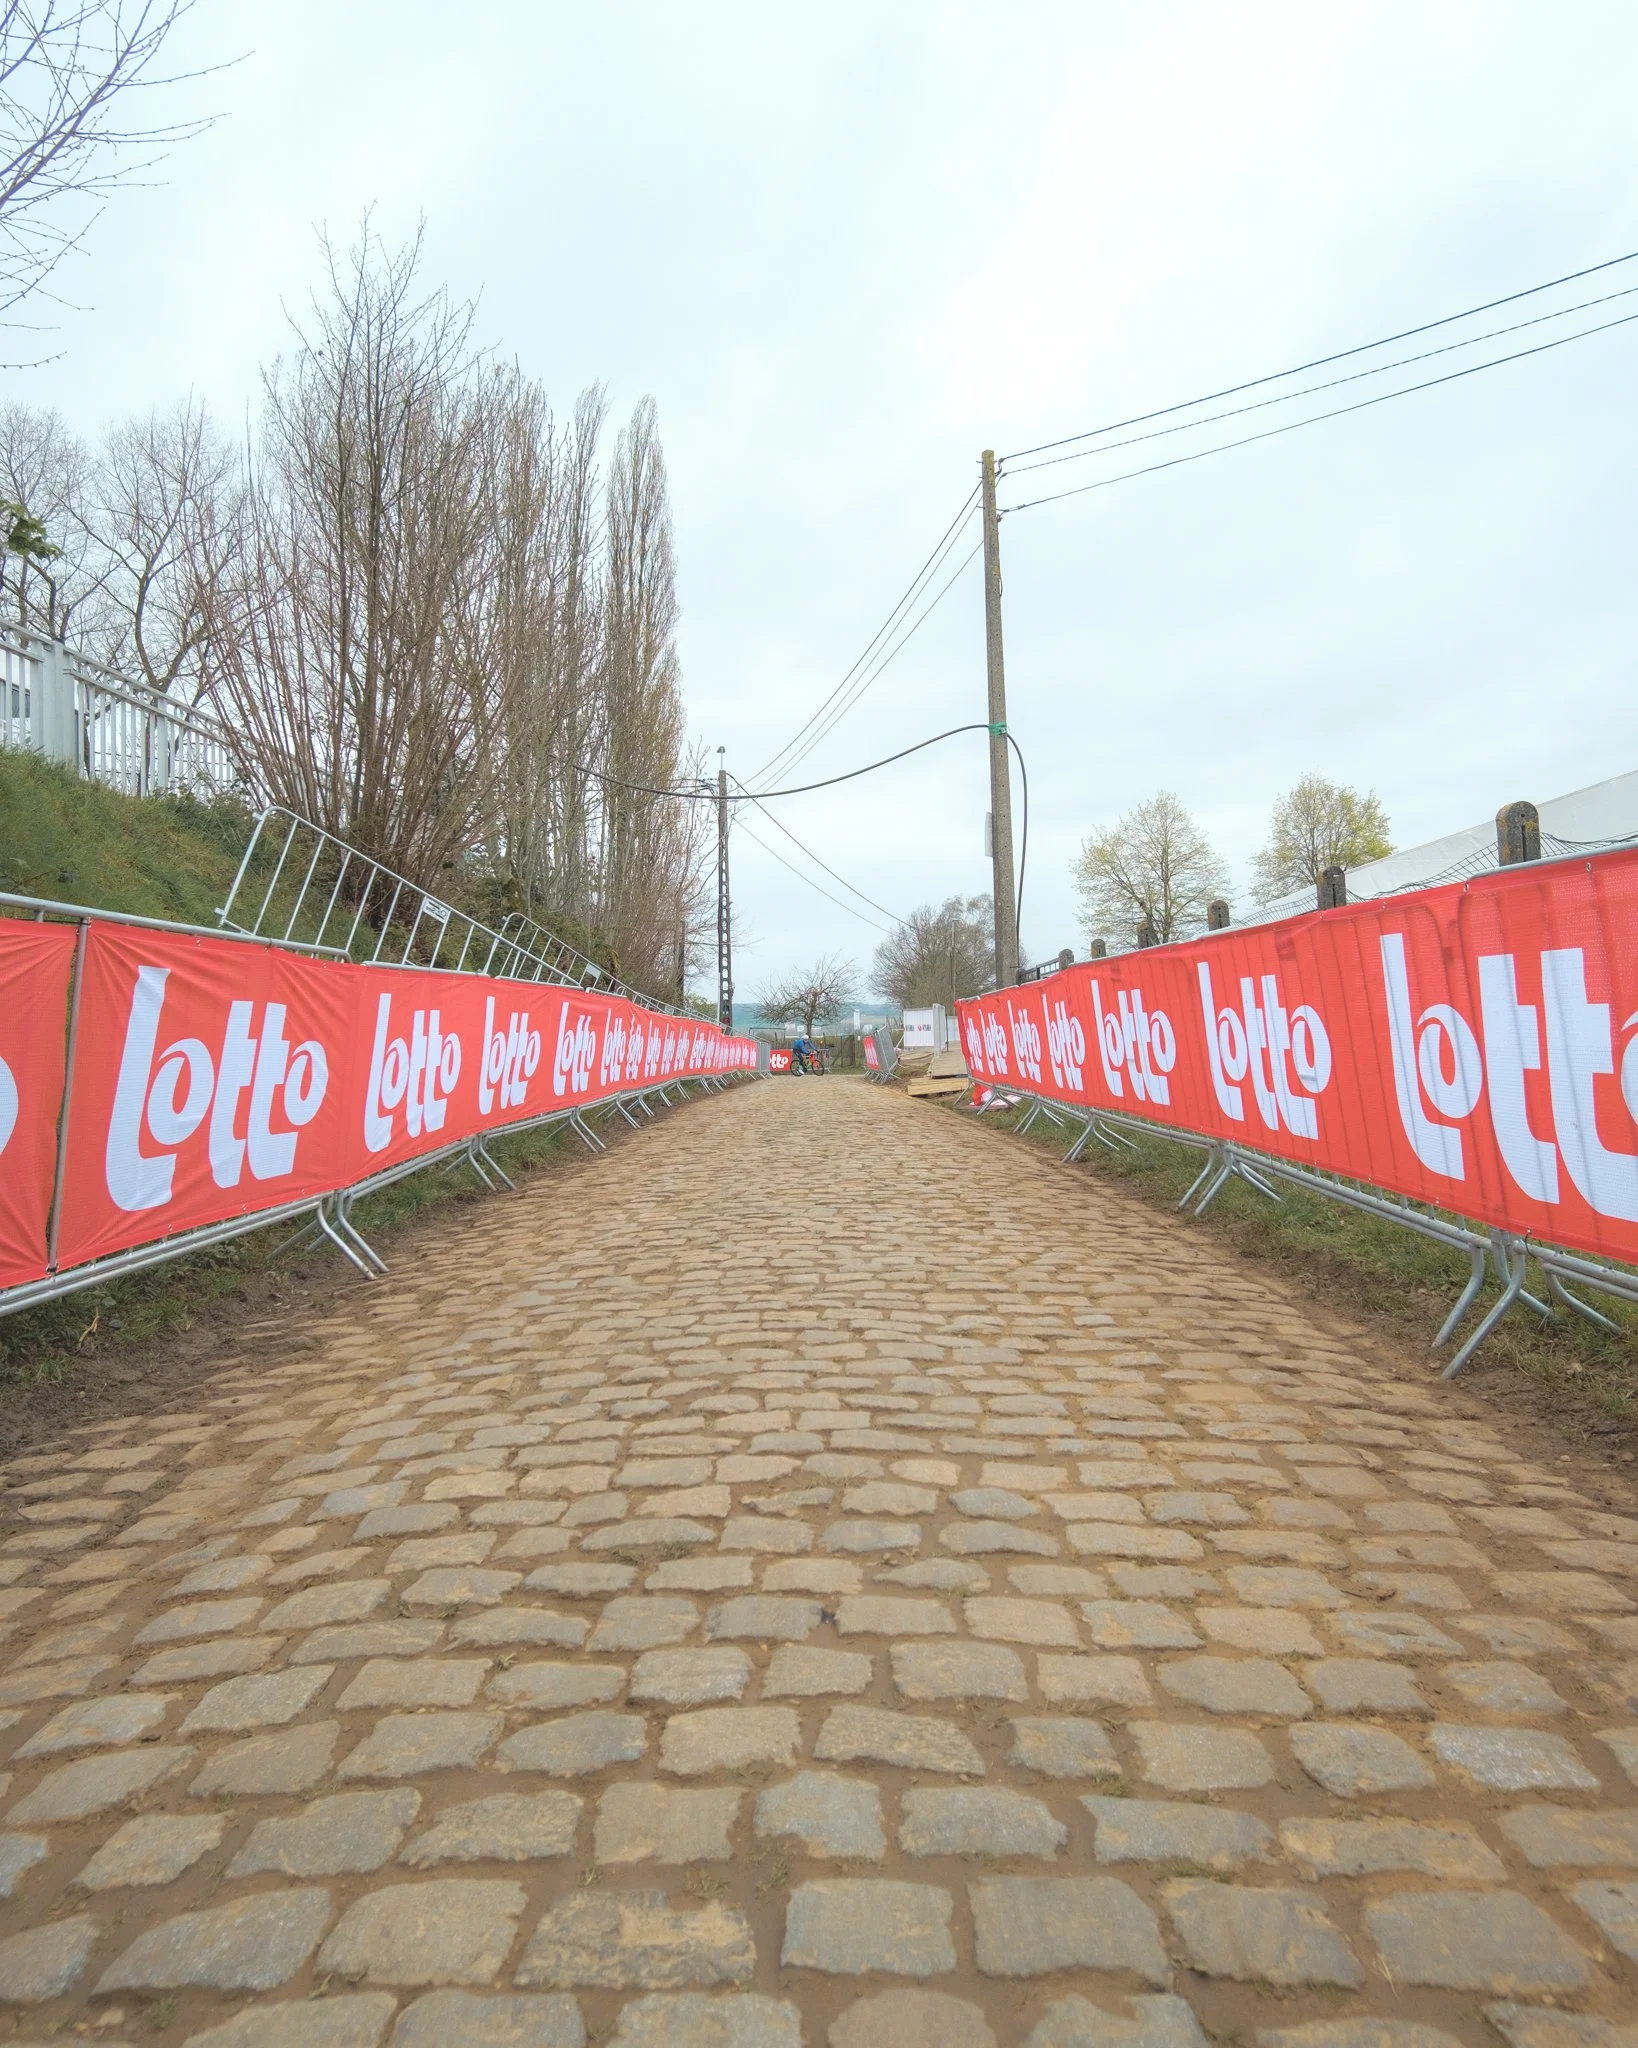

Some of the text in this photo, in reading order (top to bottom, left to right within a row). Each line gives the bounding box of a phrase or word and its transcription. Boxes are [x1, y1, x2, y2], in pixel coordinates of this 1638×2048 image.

[106, 965, 329, 1211] lotto
[364, 993, 462, 1152] lotto
[479, 996, 541, 1115] lotto
[553, 1001, 596, 1096] lotto
[600, 1008, 626, 1087] lotto
[769, 1053, 788, 1069] tto
[1008, 1000, 1042, 1084] lotto
[1042, 993, 1085, 1091] lotto
[1090, 979, 1176, 1106] lotto
[1197, 961, 1332, 1140] lotto
[1380, 933, 1638, 1222] lott
